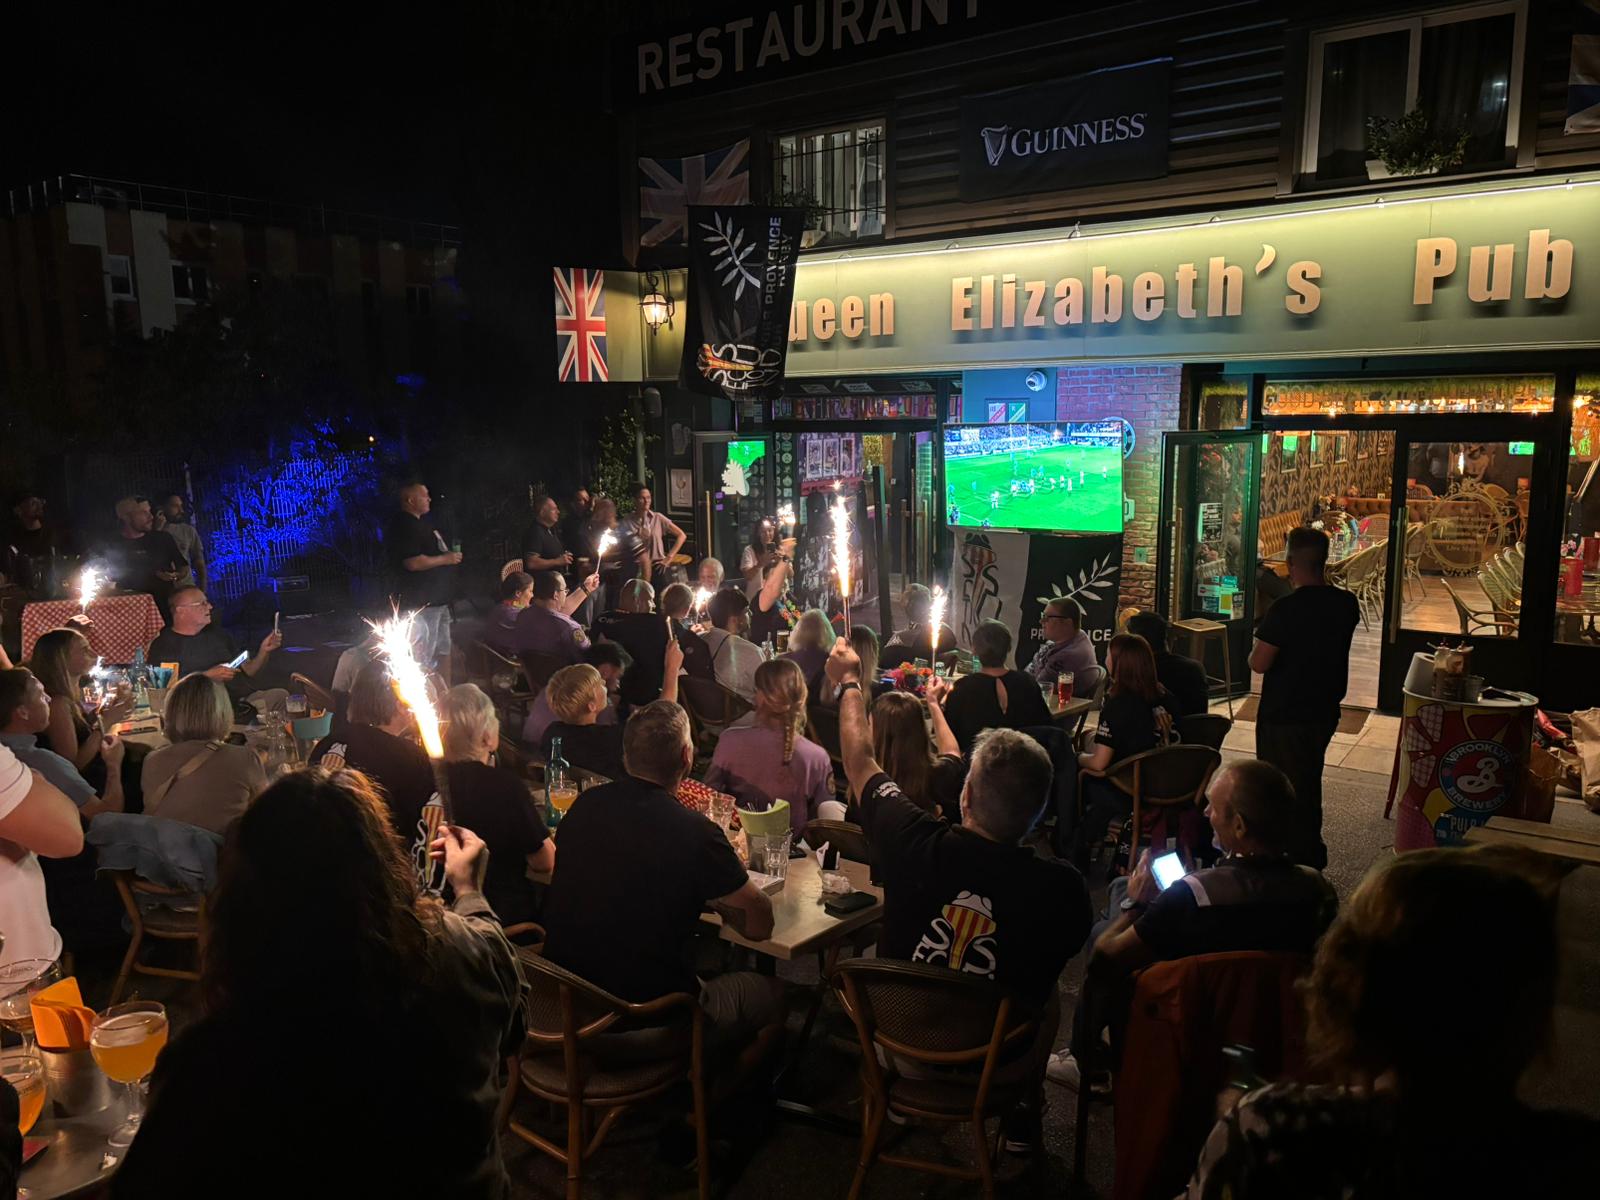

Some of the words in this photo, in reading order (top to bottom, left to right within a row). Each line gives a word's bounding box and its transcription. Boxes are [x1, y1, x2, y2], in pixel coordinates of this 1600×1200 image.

[1011, 112, 1145, 157] GUINNESS
[788, 292, 895, 342] ueen
[951, 244, 1322, 331] Elizabeth's
[1413, 229, 1574, 304] Pub
[1447, 786, 1509, 810] BREWER
